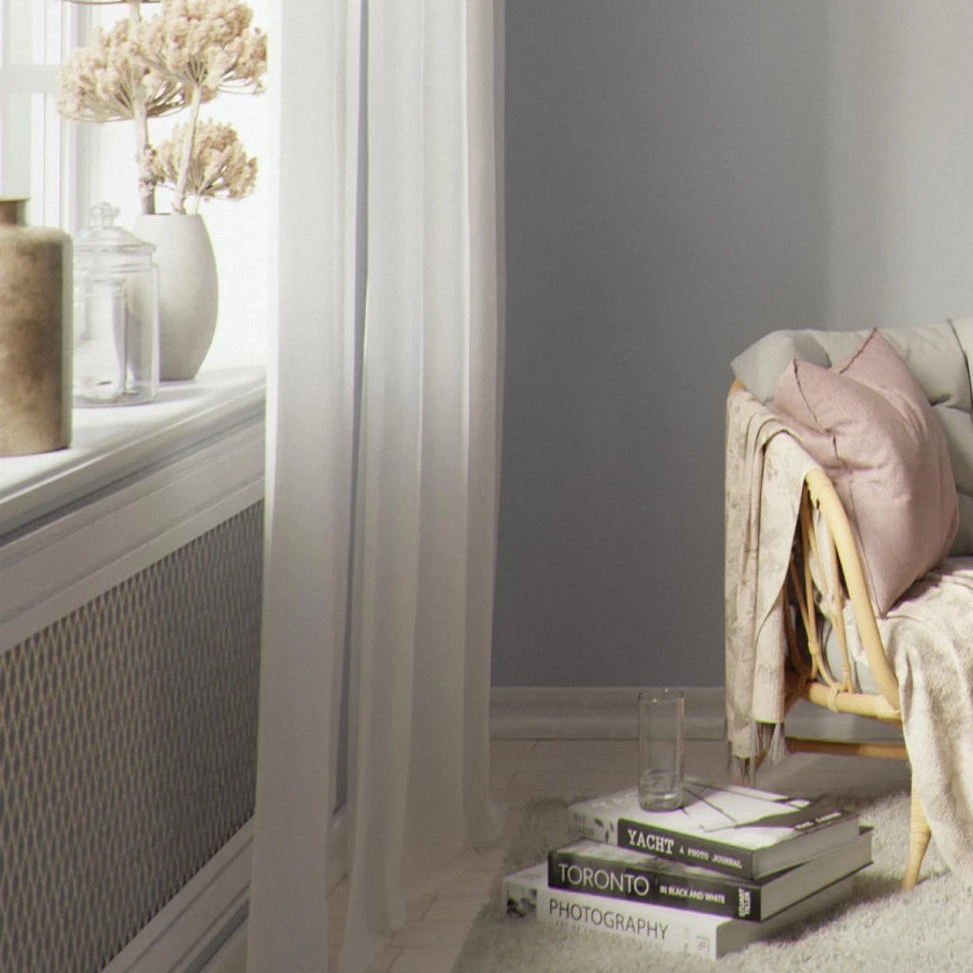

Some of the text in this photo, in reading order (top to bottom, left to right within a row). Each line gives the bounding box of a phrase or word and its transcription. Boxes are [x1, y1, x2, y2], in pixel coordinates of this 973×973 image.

[627, 829, 743, 870] YACHT A PHOTO JOURNAL
[558, 863, 650, 897] TORONTO
[668, 886, 688, 899] BLACK
[688, 889, 705, 901] AND
[704, 891, 726, 905] WHITE
[549, 898, 669, 941] PHOTOGRAPHY
